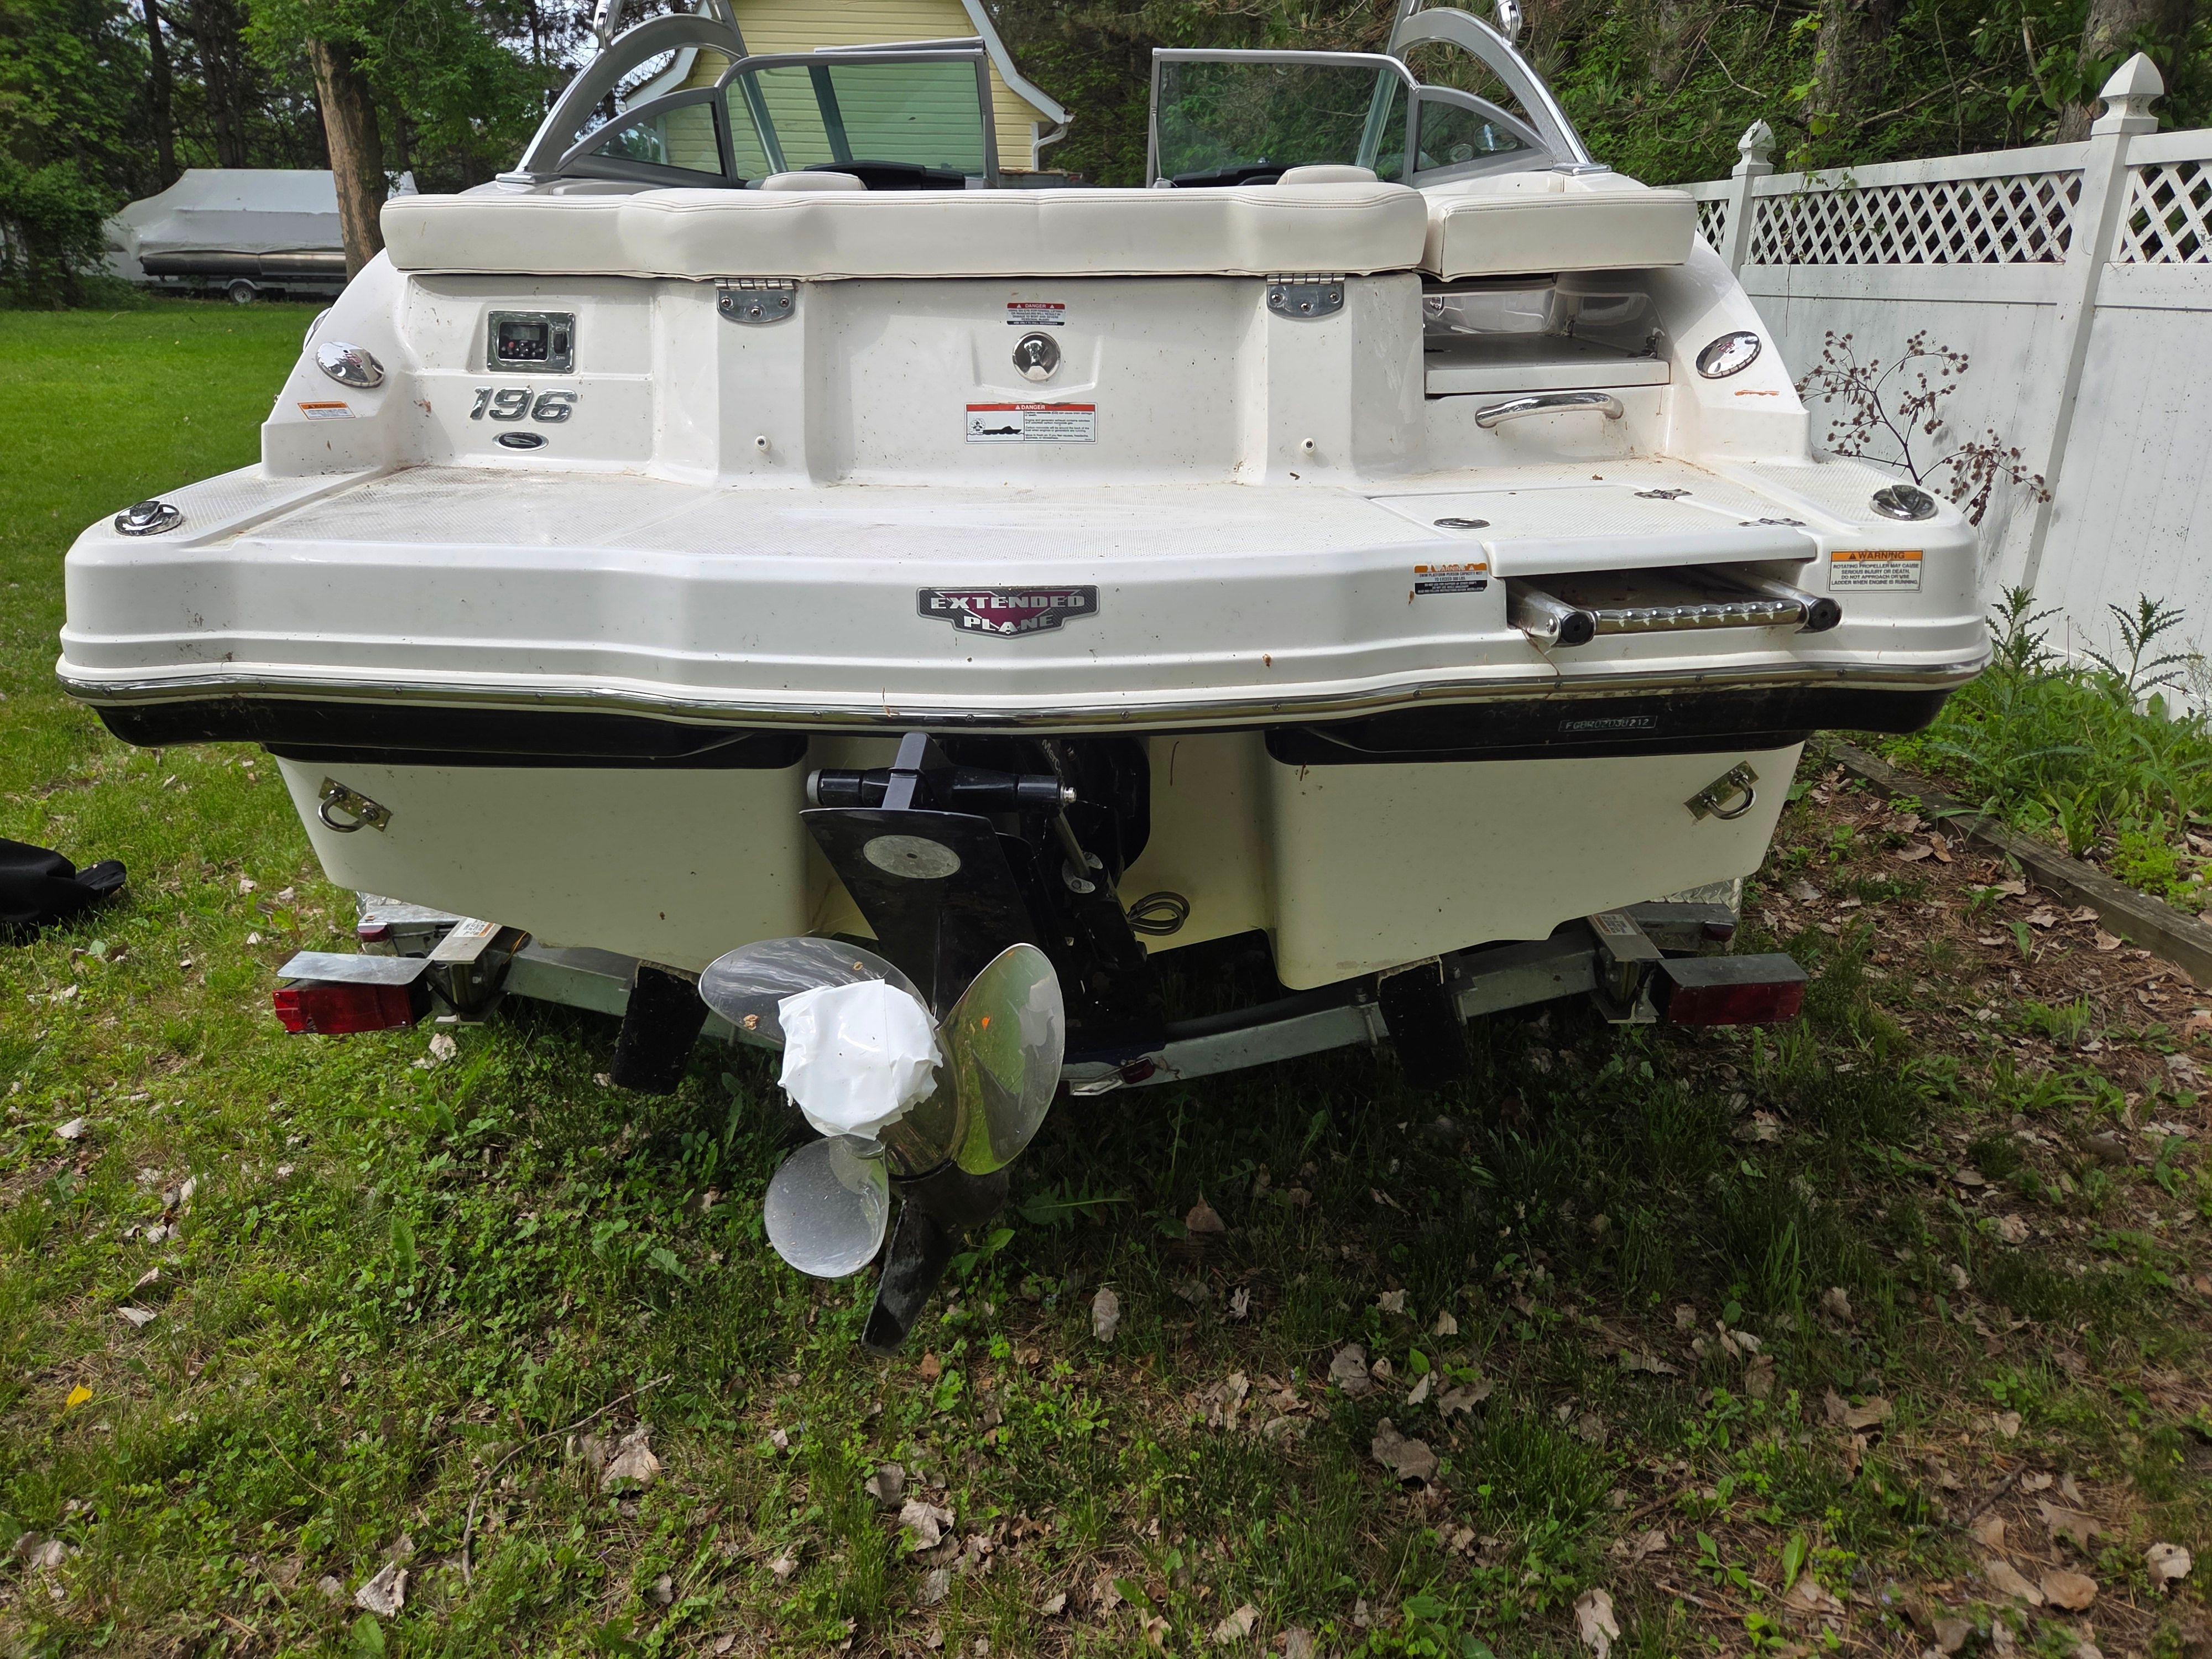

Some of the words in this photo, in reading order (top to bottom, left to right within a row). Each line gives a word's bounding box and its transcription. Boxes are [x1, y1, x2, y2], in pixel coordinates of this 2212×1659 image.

[470, 386, 578, 423] 196
[931, 596, 1085, 609] EXTENDED
[964, 615, 1053, 633] PLANE
